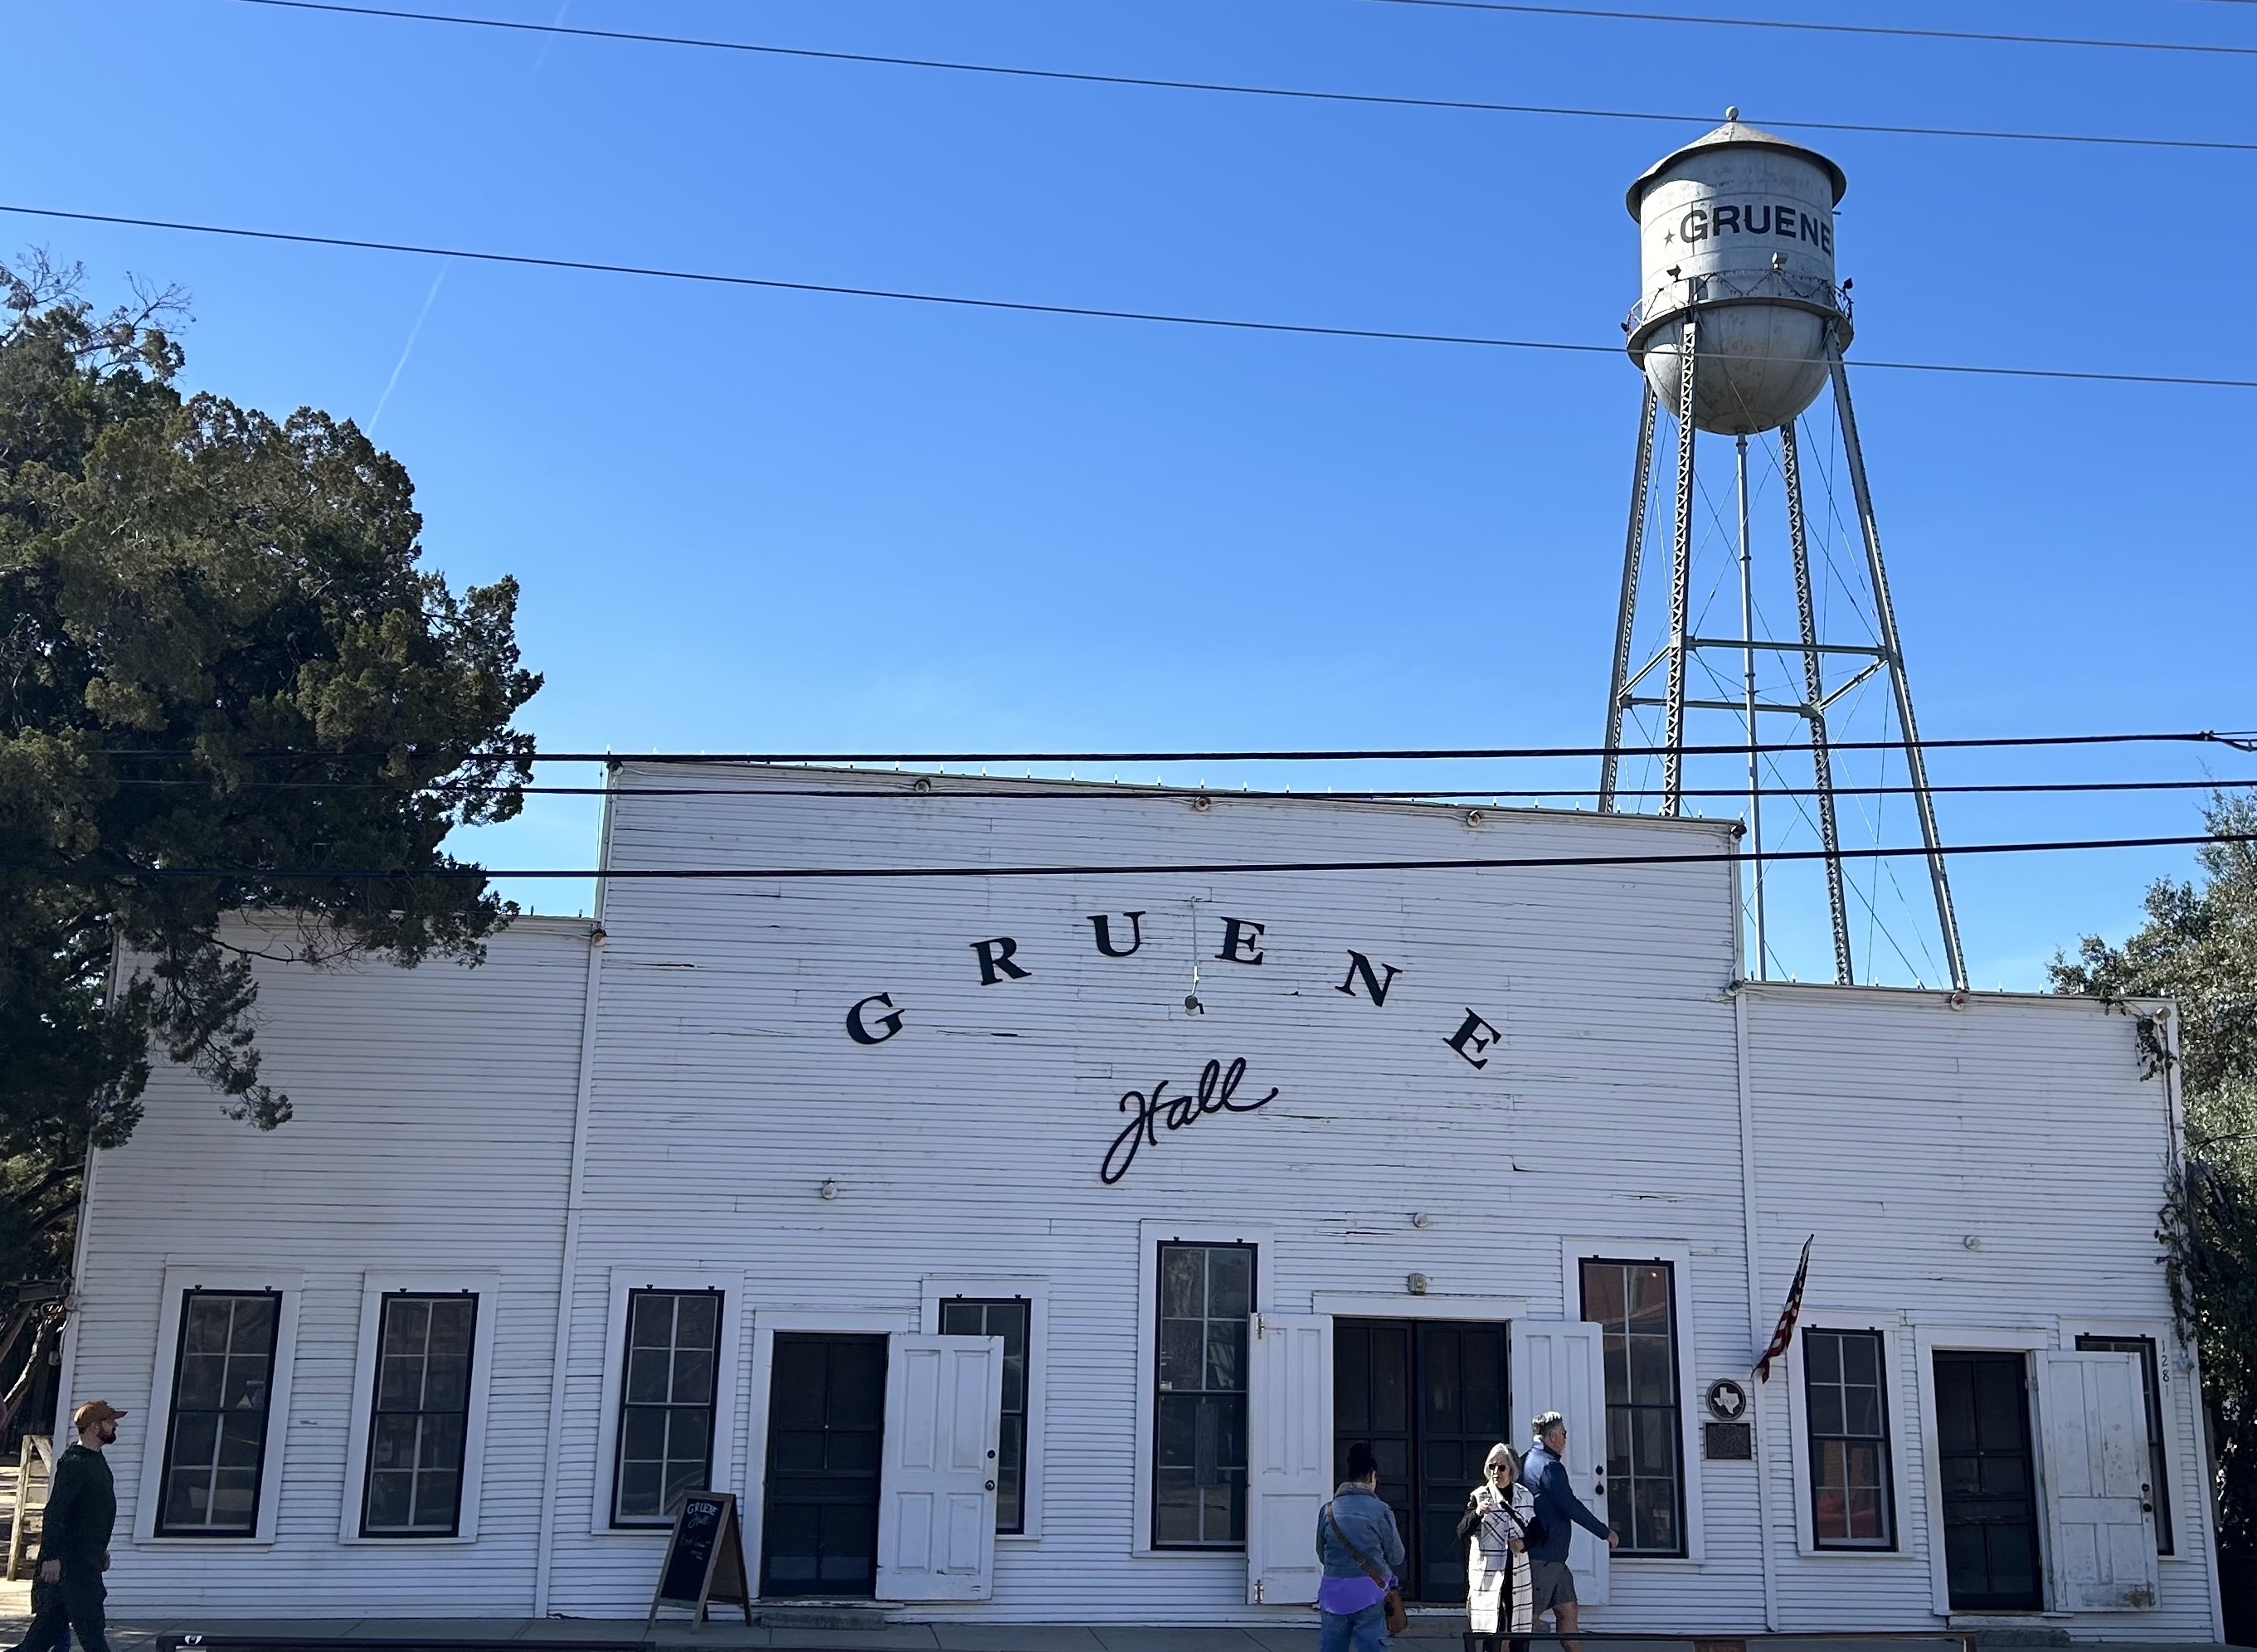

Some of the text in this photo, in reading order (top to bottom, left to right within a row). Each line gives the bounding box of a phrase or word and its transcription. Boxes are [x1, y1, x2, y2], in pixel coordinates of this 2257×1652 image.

[1680, 205, 1831, 257] GRUENE
[845, 911, 1502, 1070] GRUENE
[1101, 1057, 1279, 1184] Hall
[2161, 1339, 2170, 1397] 1281
